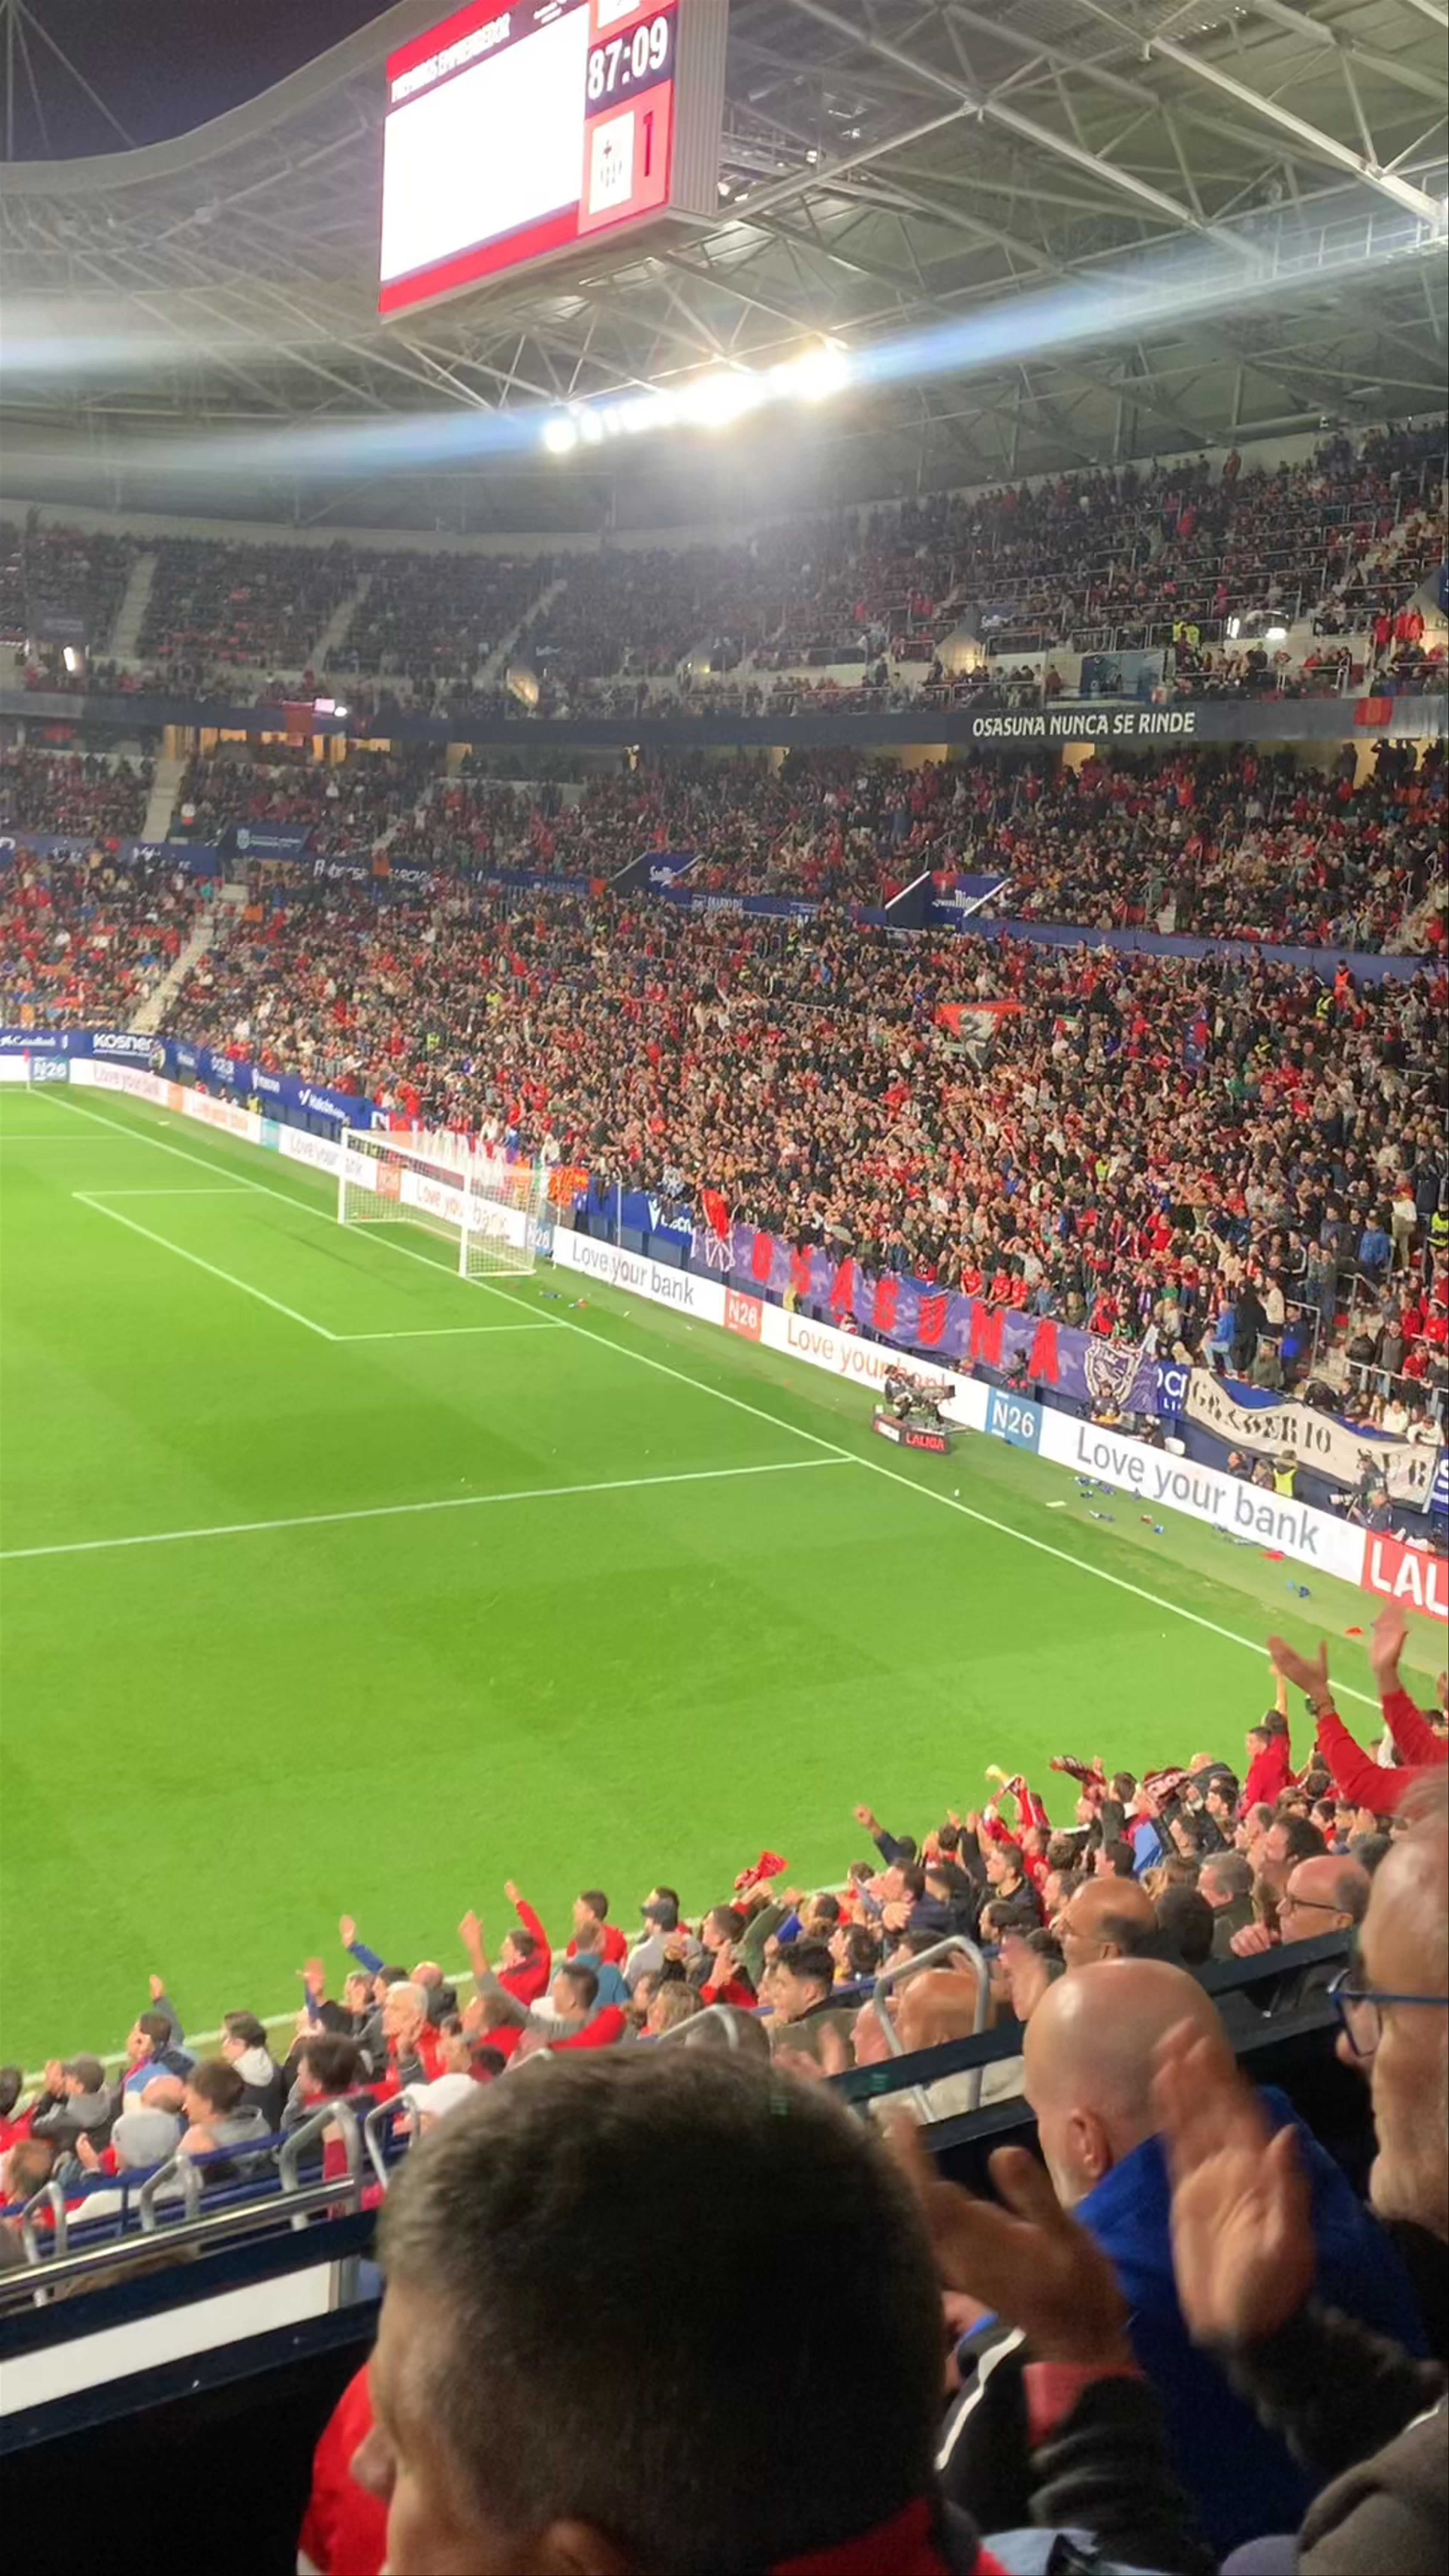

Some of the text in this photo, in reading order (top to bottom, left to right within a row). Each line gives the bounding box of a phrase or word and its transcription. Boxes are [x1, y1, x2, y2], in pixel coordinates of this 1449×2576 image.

[588, 16, 668, 100] 87:09
[643, 111, 654, 177] 1
[973, 712, 1195, 737] OSASUNA NUNCA SE RINDE
[573, 1236, 694, 1305] Love your bank
[729, 1296, 757, 1328] N26
[788, 1316, 834, 1360] Love
[993, 1400, 1034, 1438] N26
[1077, 1425, 1320, 1555] Love your bank
